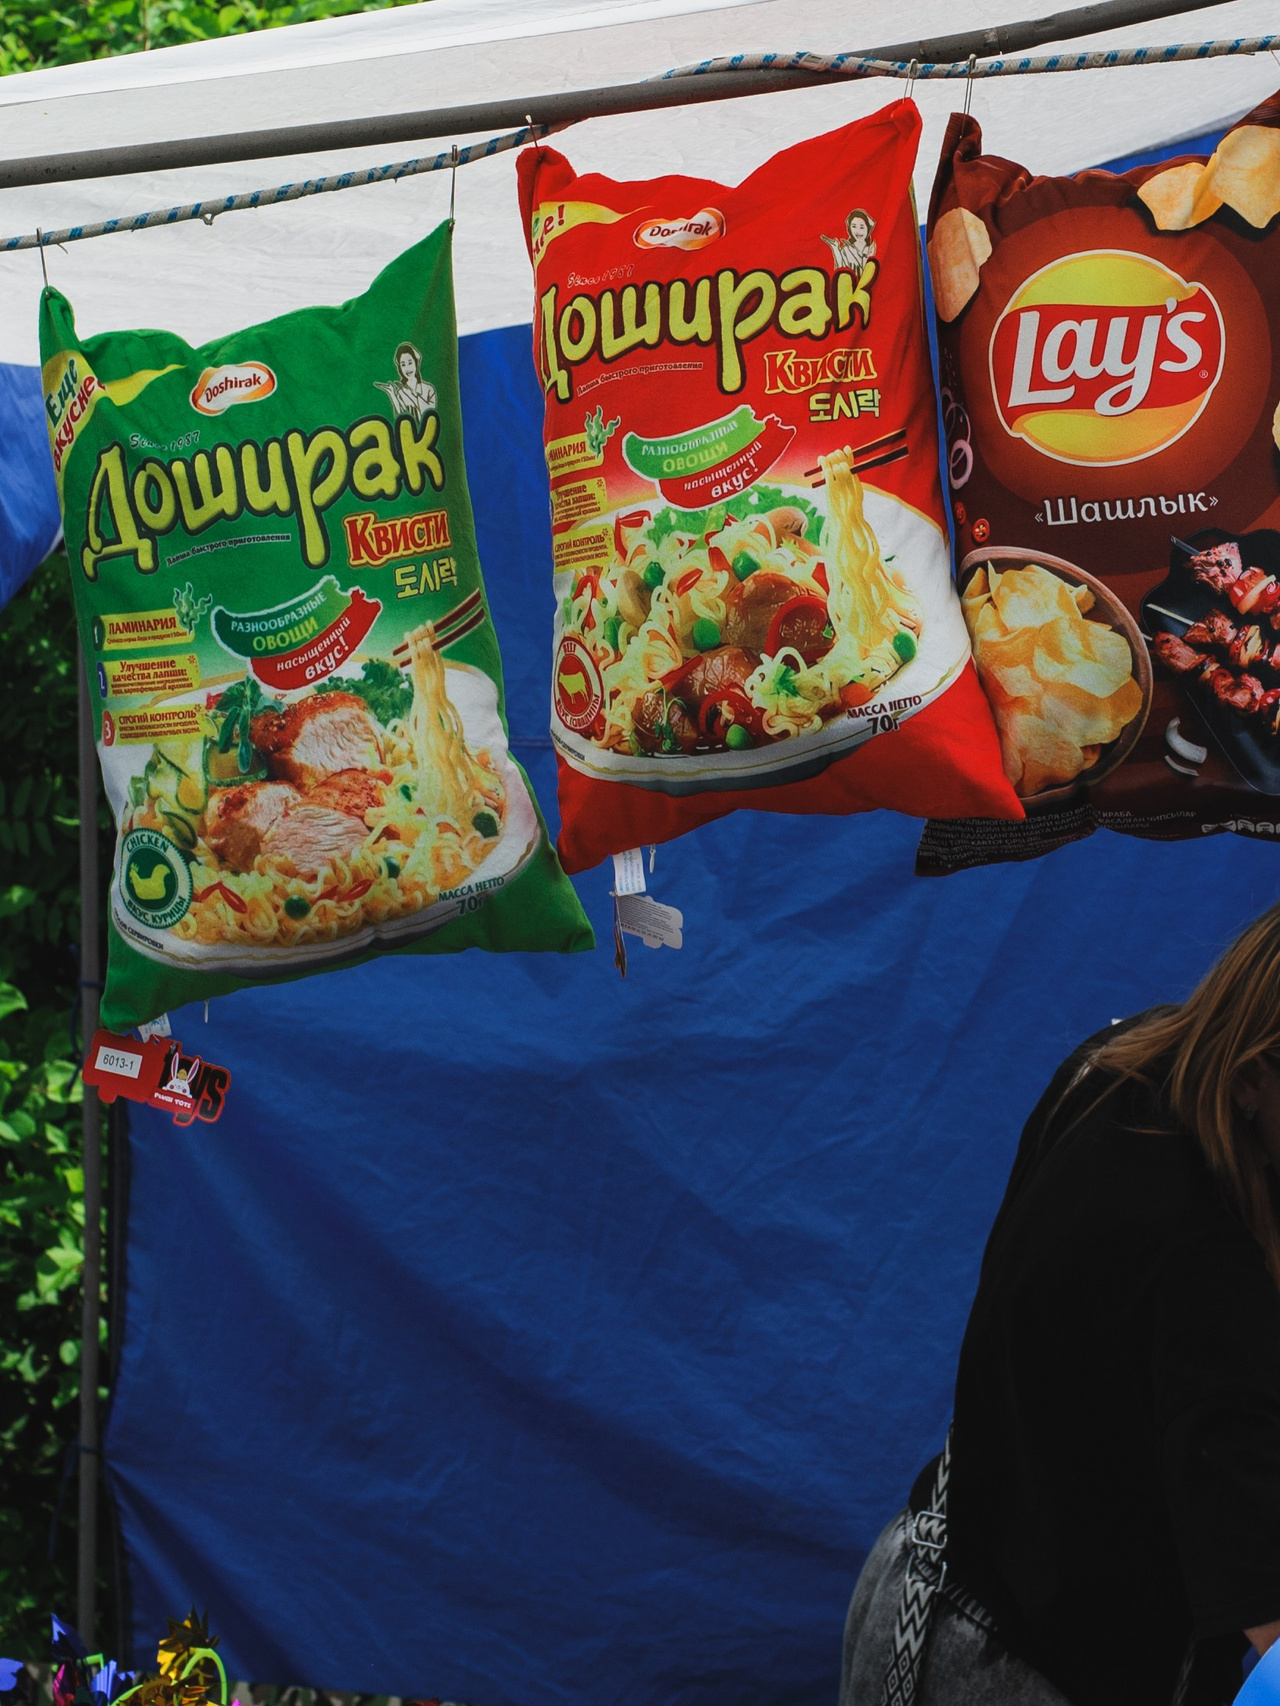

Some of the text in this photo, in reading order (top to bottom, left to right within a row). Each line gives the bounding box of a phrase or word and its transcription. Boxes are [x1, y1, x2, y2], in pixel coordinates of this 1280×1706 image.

[1006, 296, 1207, 417] Lay's
[205, 372, 262, 403] Doshirak
[808, 388, 881, 422] 도시락
[170, 431, 200, 450] 1987
[663, 441, 728, 473] ОВОЩИ
[711, 458, 759, 498] вкус!
[81, 412, 446, 580] Доширак
[1034, 492, 1219, 525] «Шашлык»
[395, 556, 457, 600] 도시락
[109, 617, 177, 635] ЛАМИНАРИЯ
[231, 591, 327, 632] РАЗНООБРАЗНЫЕ
[252, 616, 319, 651] ОВОЩИ
[276, 617, 351, 672] насыщенный
[120, 660, 176, 674] Улучшение
[305, 635, 349, 680] вкус!
[150, 710, 197, 722] КОНТРОЛЬ
[866, 714, 899, 735] 70г
[126, 833, 169, 853] CHICKEN
[438, 877, 505, 901] МАССА НЕТТО
[151, 896, 187, 925] КУРИЦЫ
[103, 1054, 134, 1071] 6013-1
